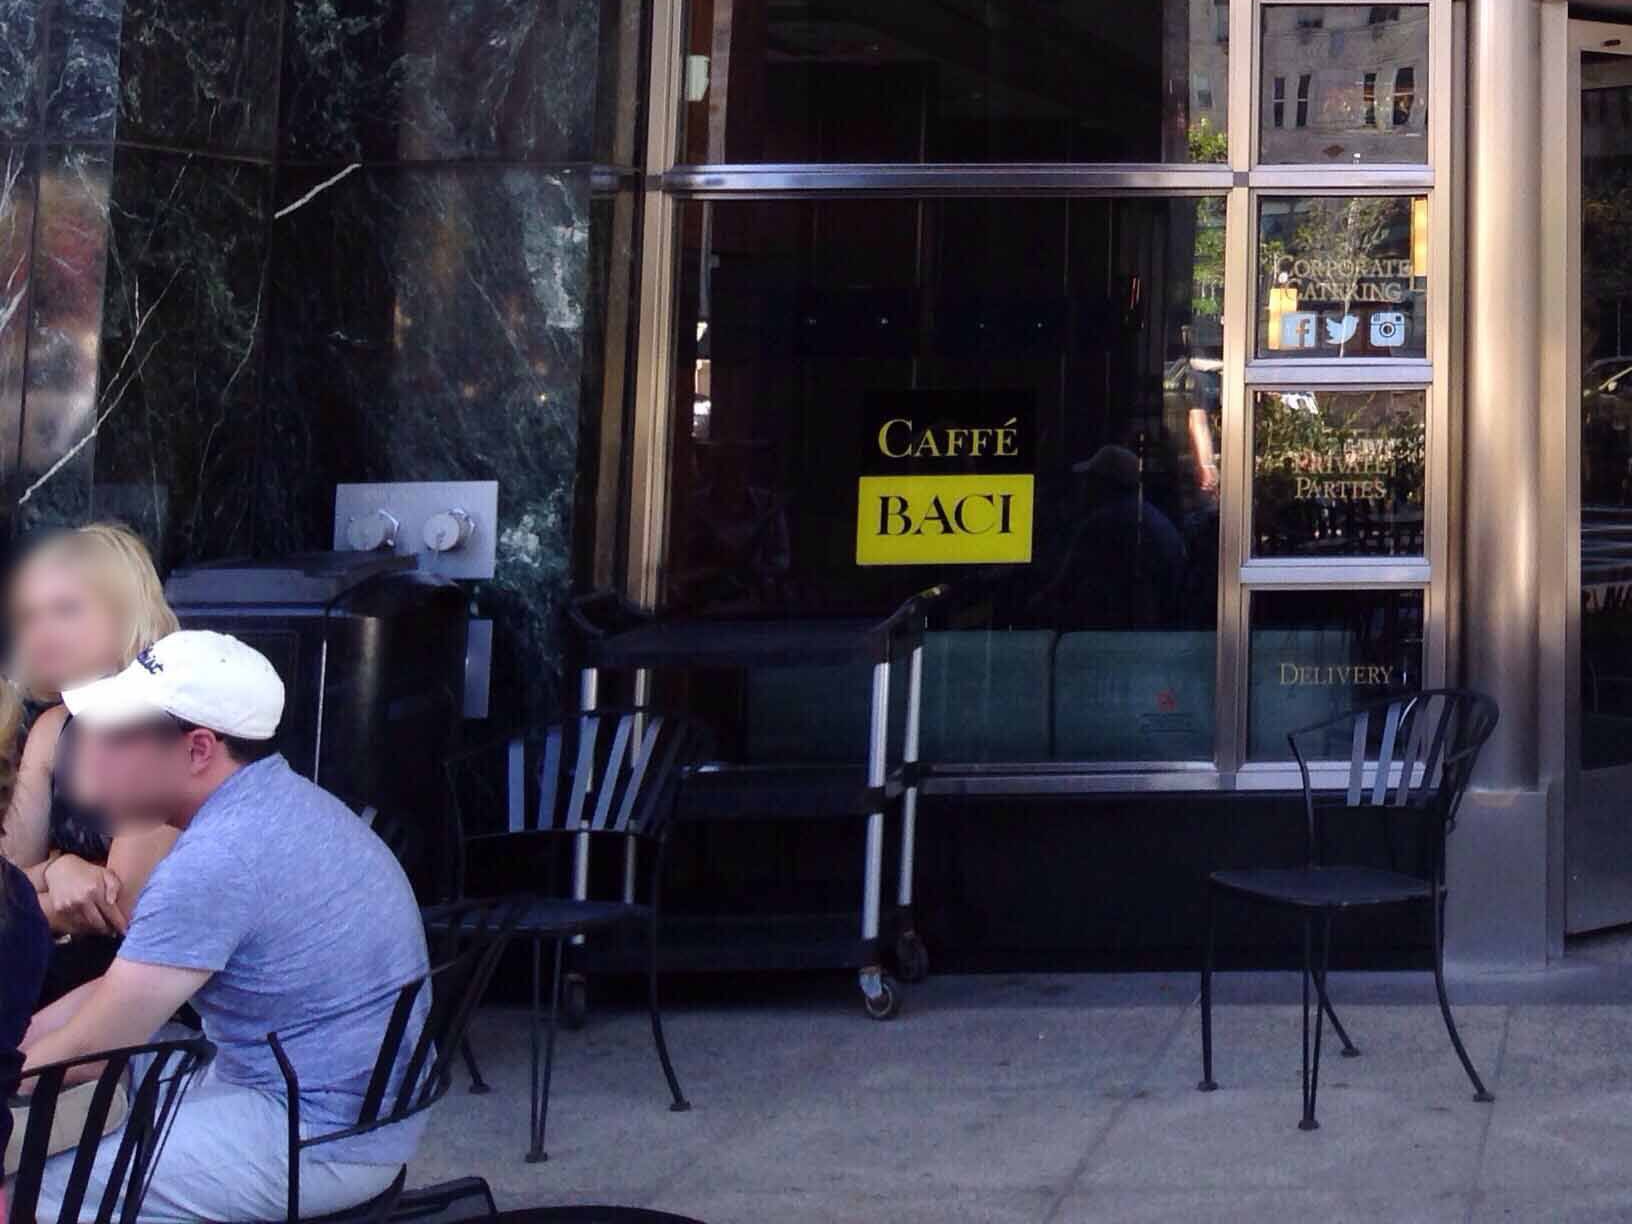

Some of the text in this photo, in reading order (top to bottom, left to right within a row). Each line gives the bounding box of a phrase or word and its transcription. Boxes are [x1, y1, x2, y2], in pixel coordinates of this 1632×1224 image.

[1275, 255, 1412, 278] CORPORATE
[1285, 279, 1402, 302] CATERING
[878, 417, 1019, 458] CAFFÉ
[1294, 476, 1387, 499] PARTIES
[876, 492, 1015, 536] BACI
[1280, 663, 1394, 685] DELIVERY
